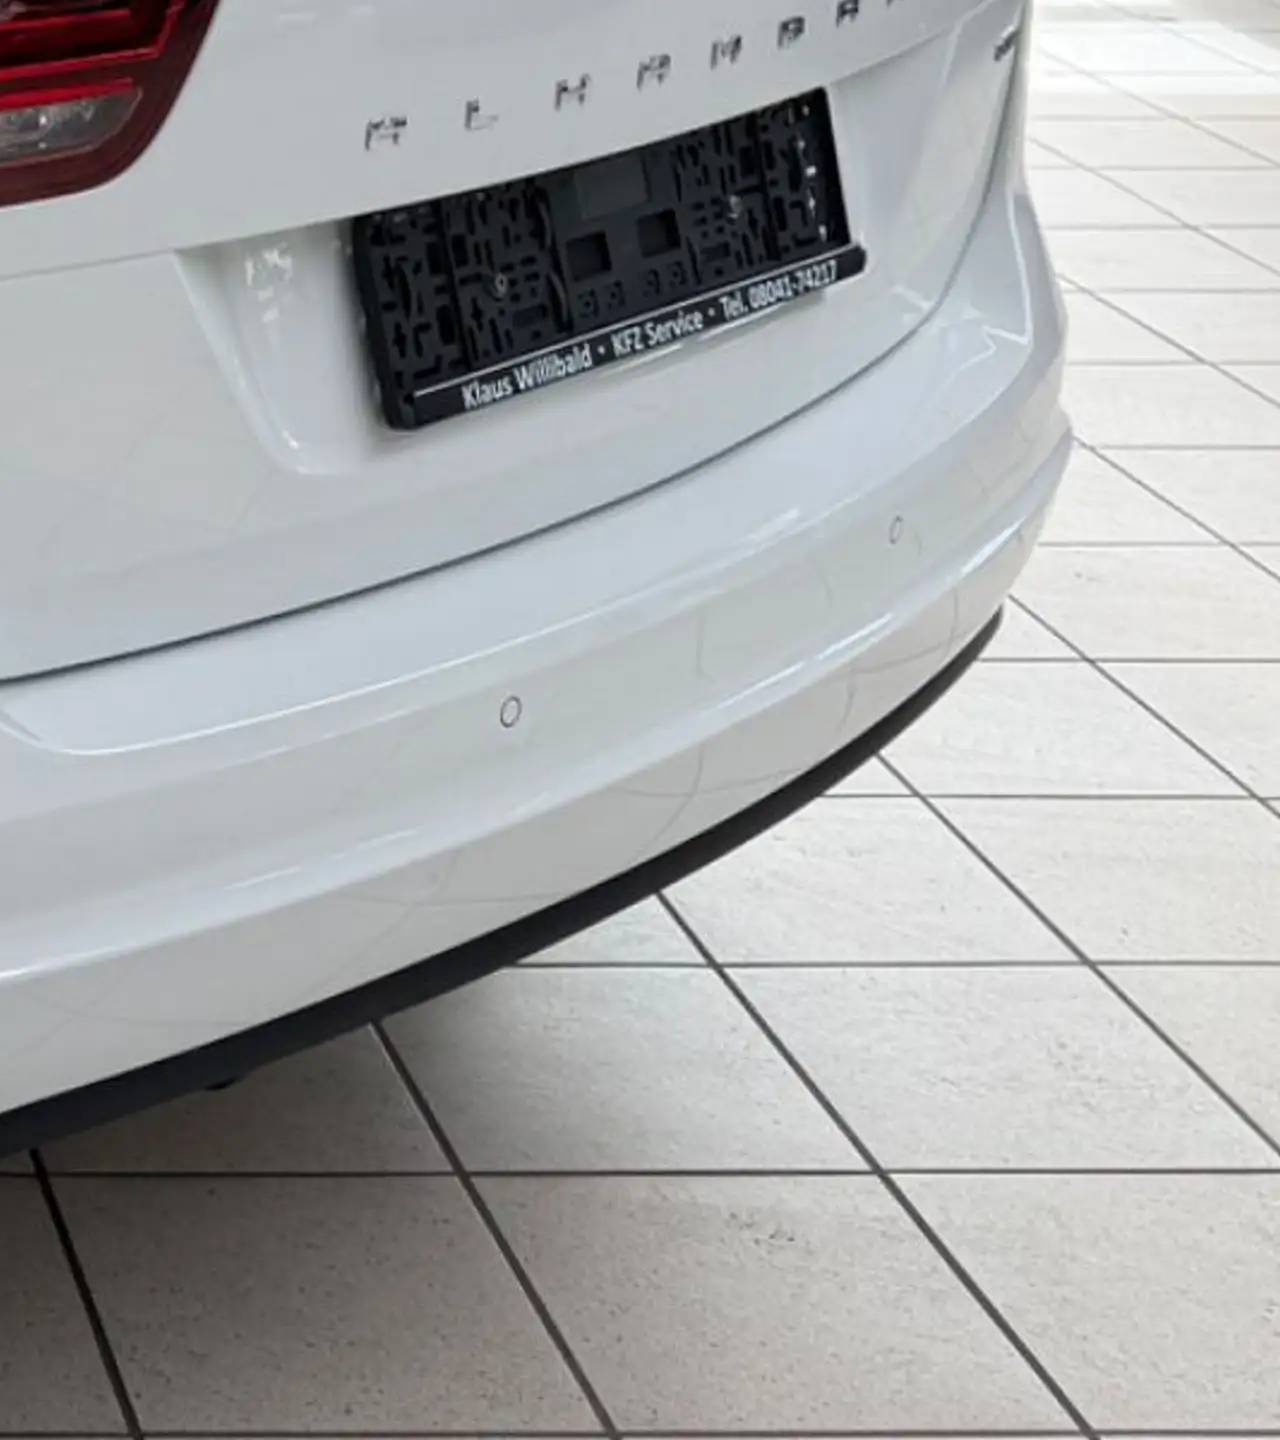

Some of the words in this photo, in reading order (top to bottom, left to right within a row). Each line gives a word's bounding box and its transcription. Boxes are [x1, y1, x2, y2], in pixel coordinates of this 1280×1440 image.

[460, 379, 513, 410] Klaus
[512, 342, 593, 391] Willibald
[610, 327, 644, 358] KFZ
[645, 310, 704, 347] Service
[718, 290, 749, 320] Tel.
[748, 259, 838, 310] 08041-74217
